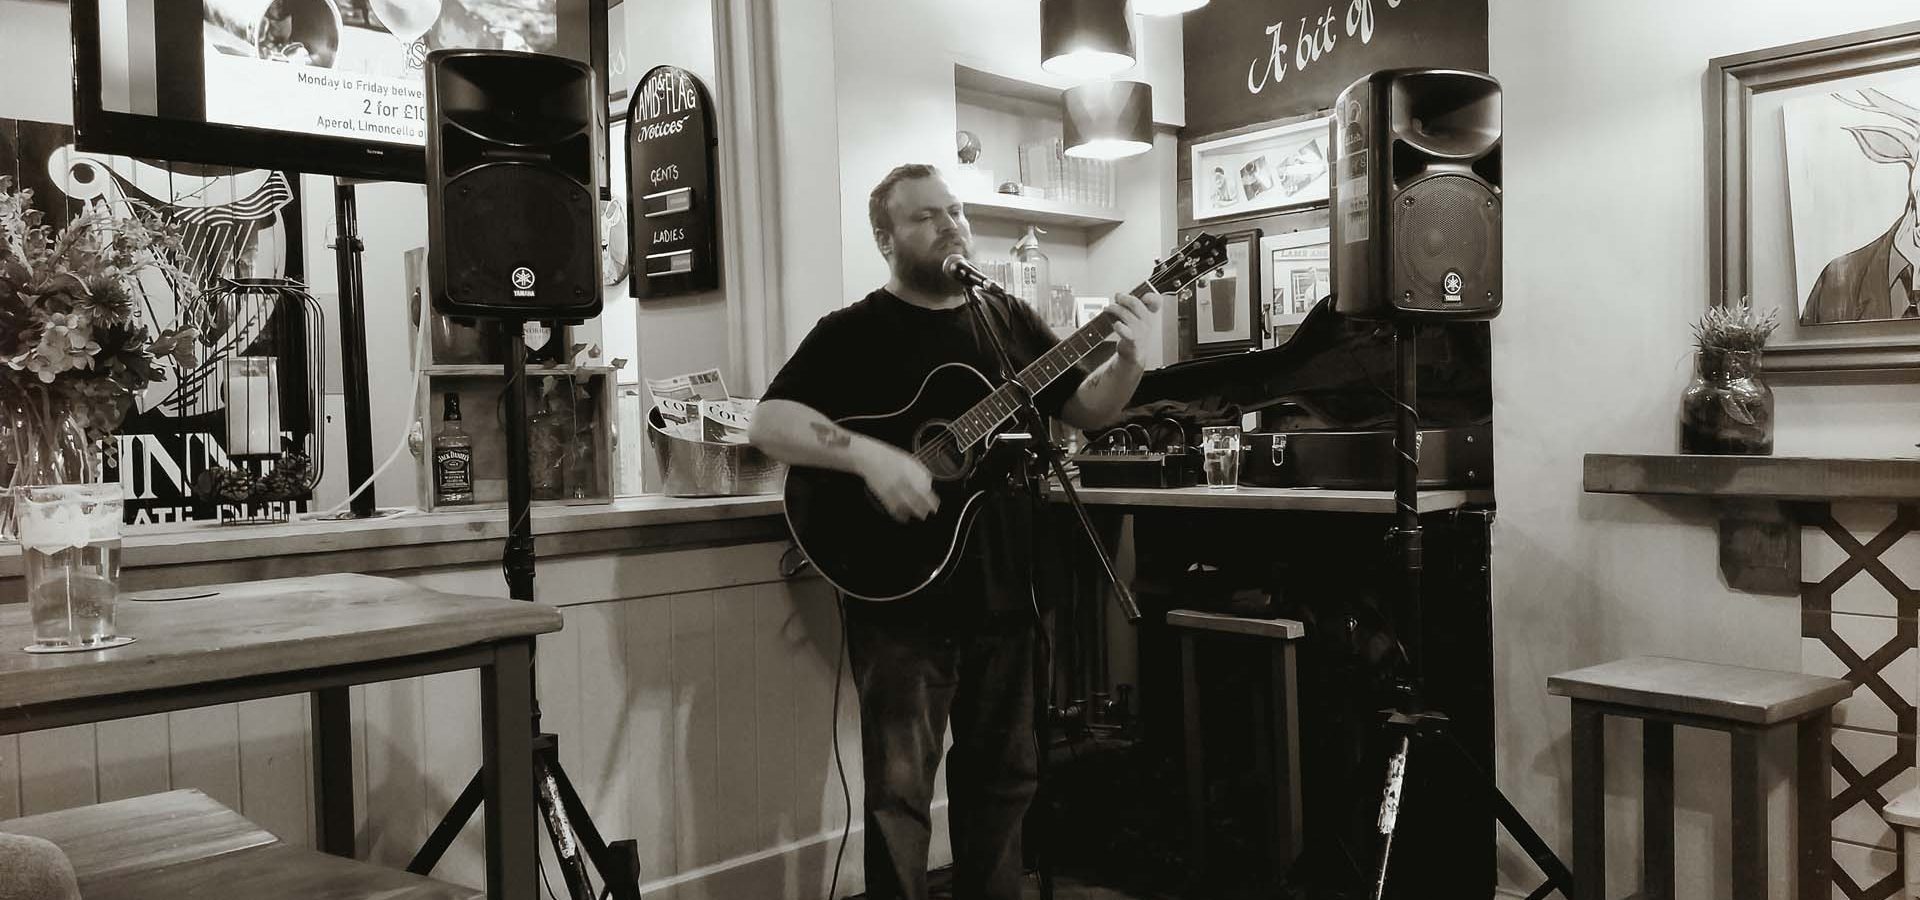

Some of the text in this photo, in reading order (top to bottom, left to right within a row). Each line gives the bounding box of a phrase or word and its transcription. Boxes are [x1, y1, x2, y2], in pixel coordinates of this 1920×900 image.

[1248, 21, 1287, 94] A
[1296, 6, 1336, 71] bit
[298, 72, 339, 91] Monday
[356, 80, 389, 97] Friday
[391, 86, 425, 99] betwe
[363, 99, 372, 115] 2
[377, 101, 399, 118] for
[317, 115, 355, 131] Aperol,
[358, 120, 415, 137] Limoncello
[638, 115, 690, 143] Notices
[650, 164, 679, 187] GENTS
[653, 228, 685, 244] LADIES
